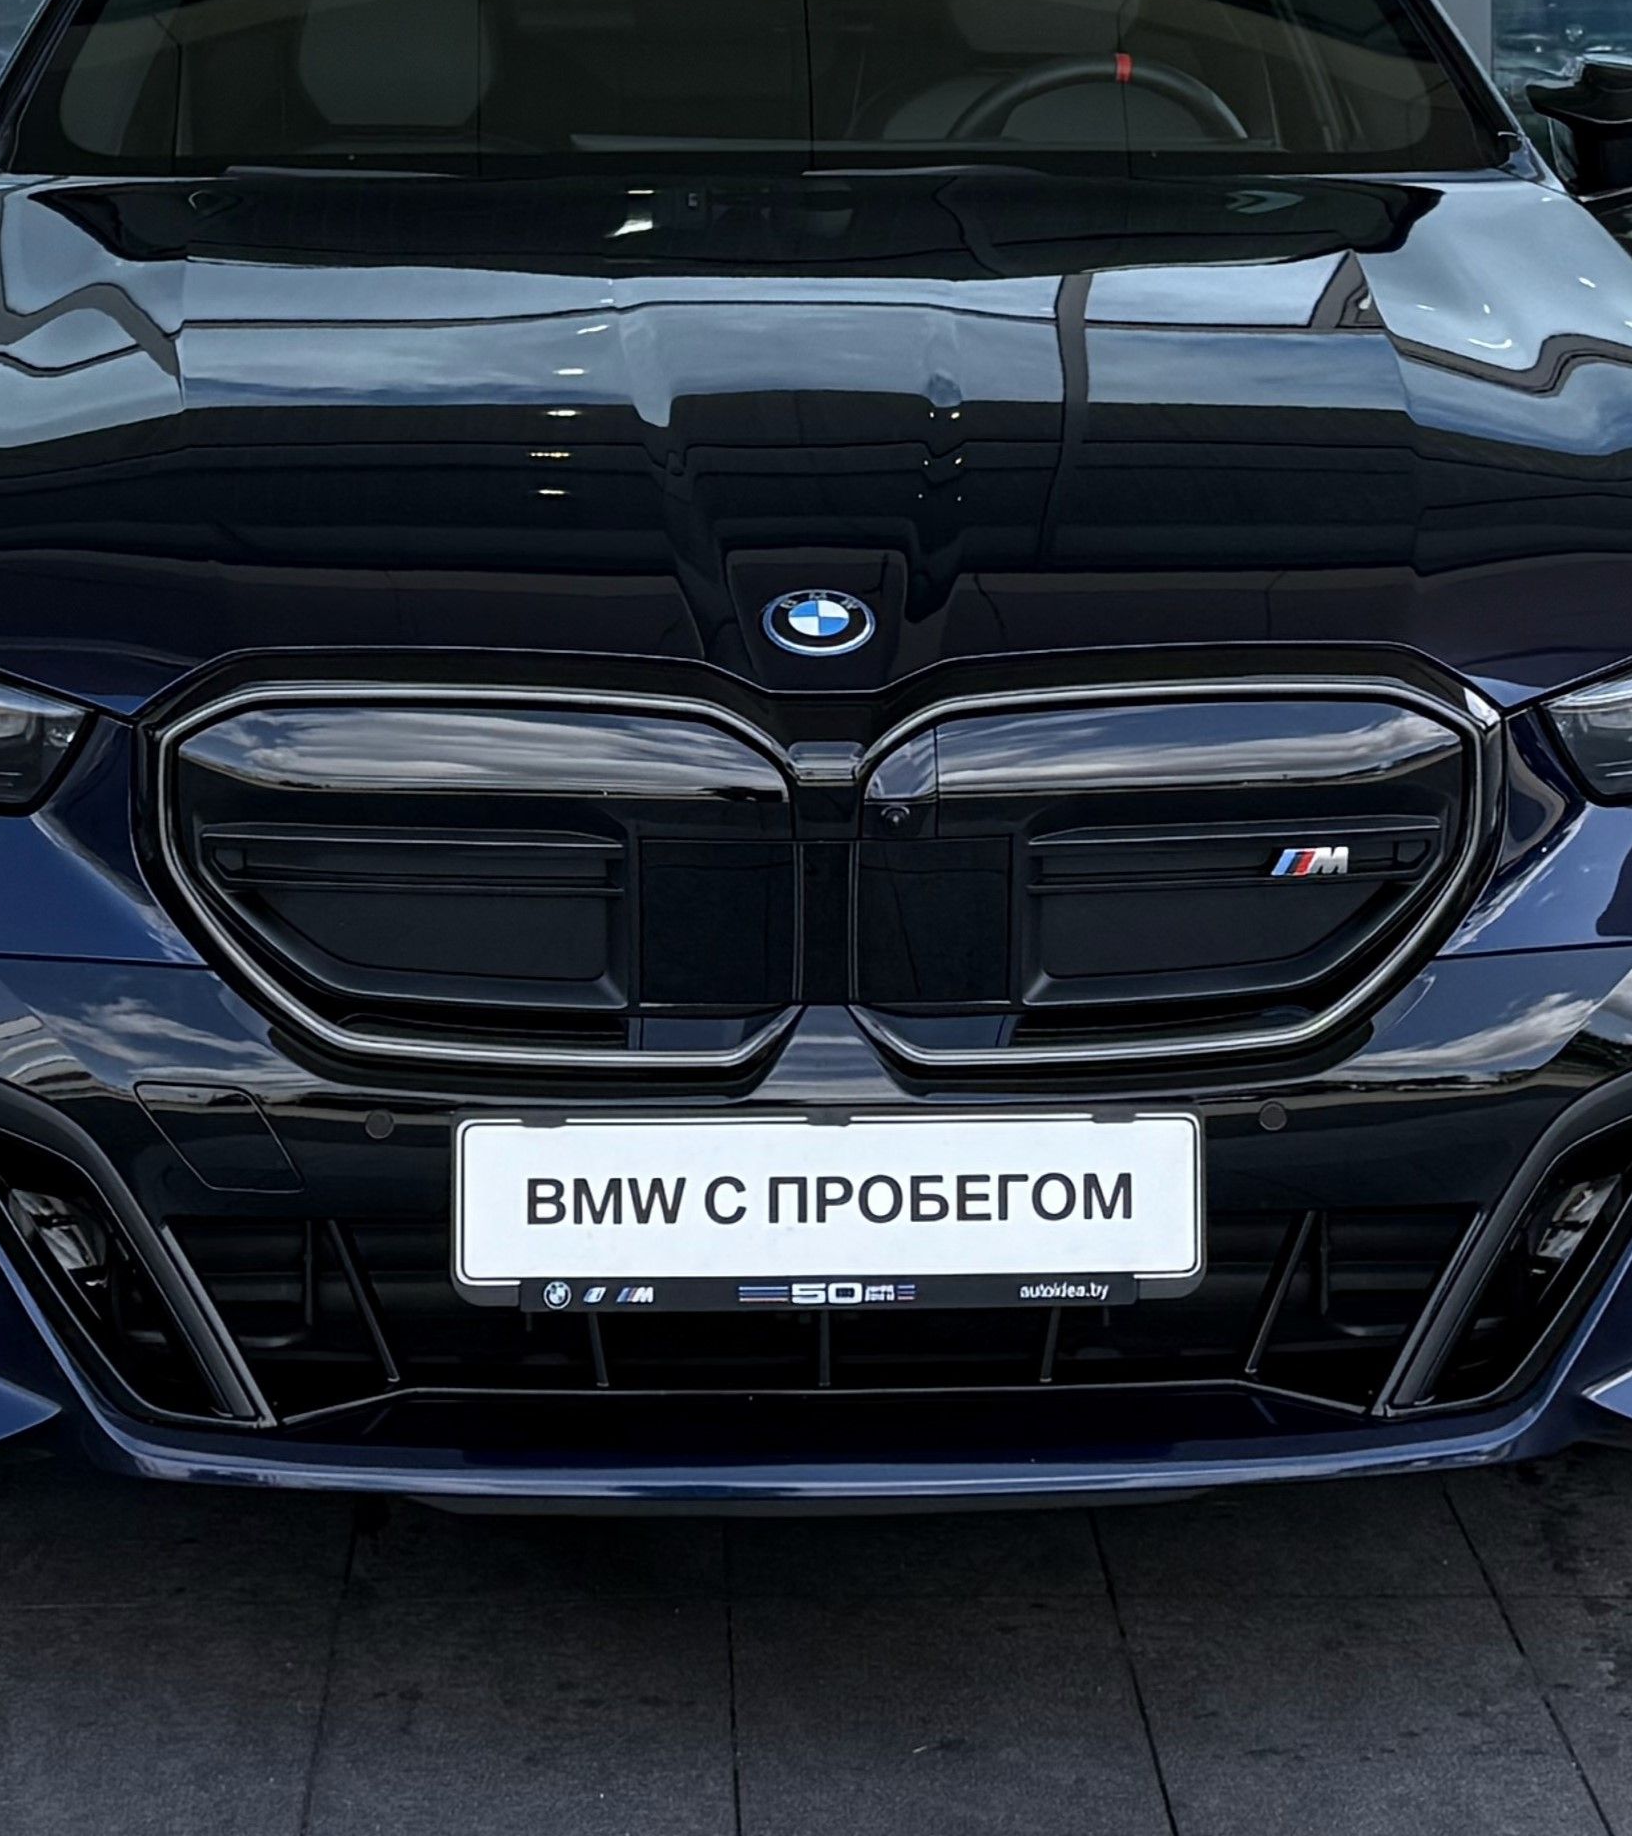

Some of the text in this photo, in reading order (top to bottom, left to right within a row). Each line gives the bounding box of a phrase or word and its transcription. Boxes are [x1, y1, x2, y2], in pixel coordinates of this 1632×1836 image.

[528, 1173, 1131, 1224] BMW С ПРОБЕГОМ
[792, 1283, 862, 1303] 50
